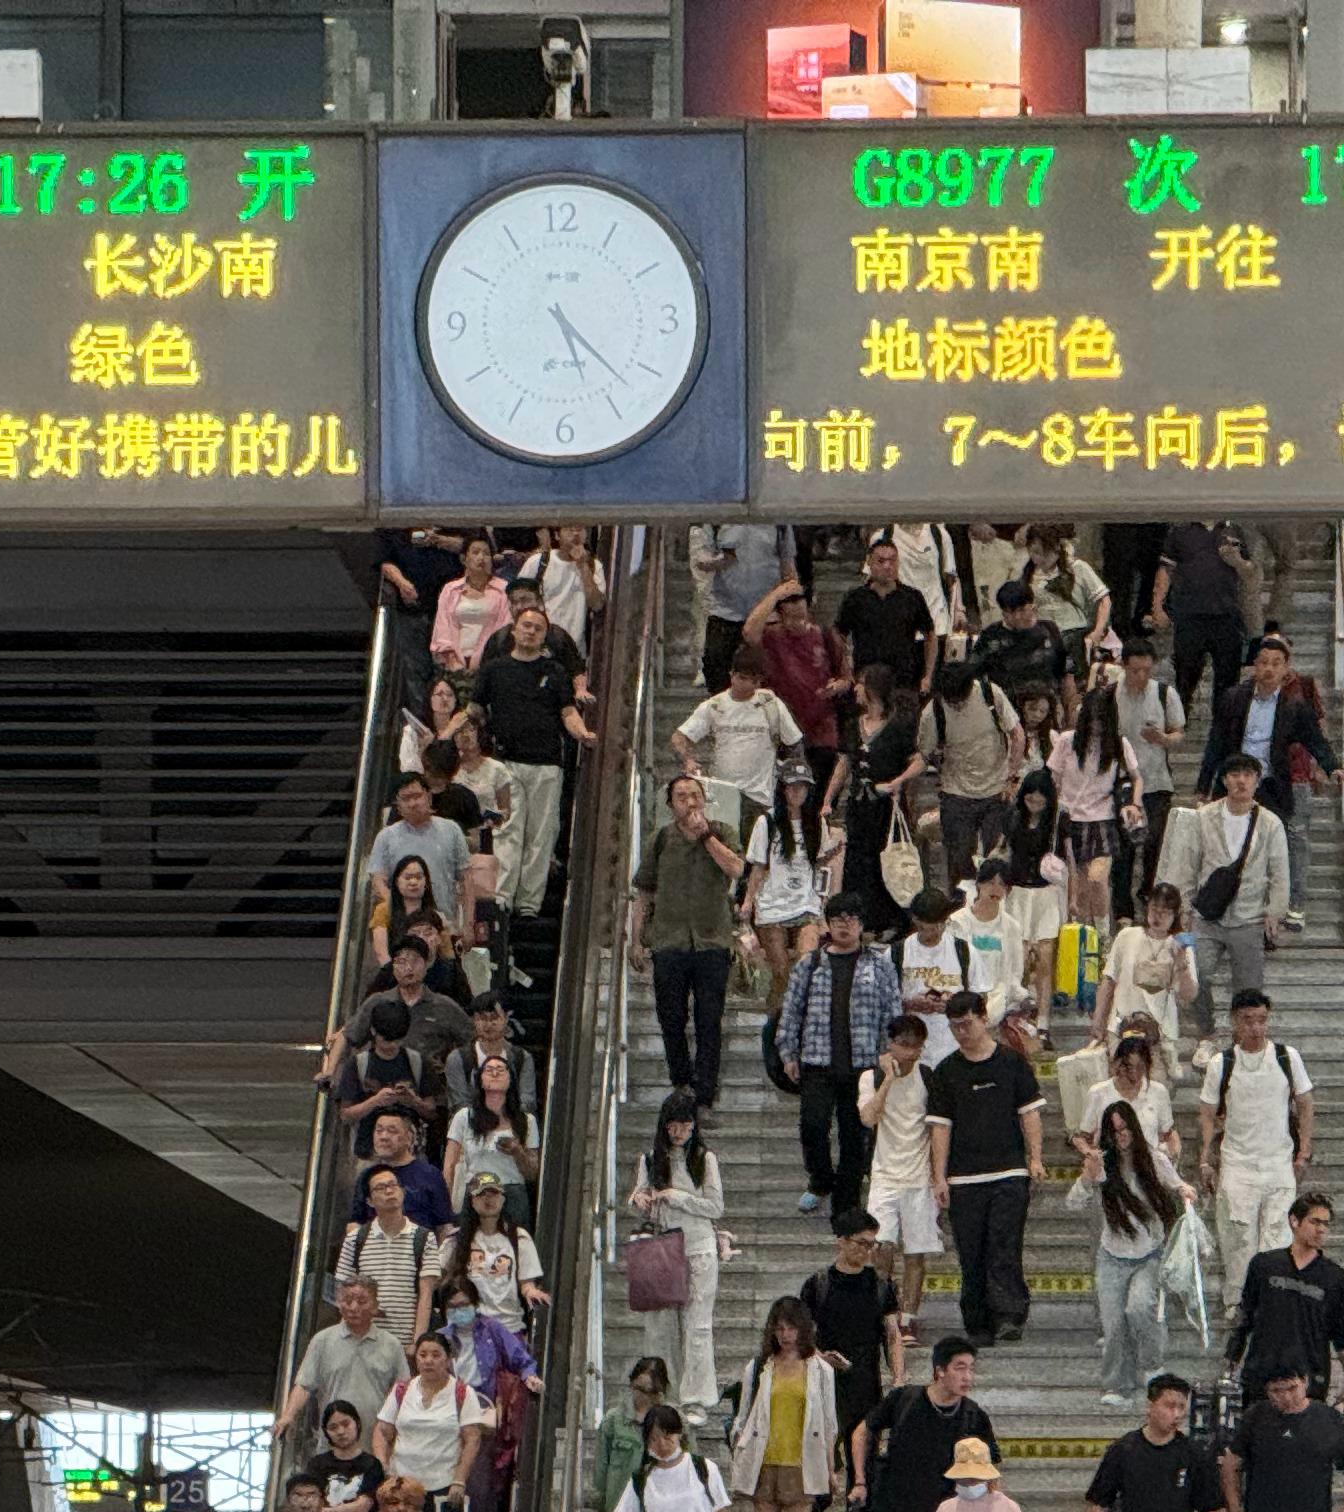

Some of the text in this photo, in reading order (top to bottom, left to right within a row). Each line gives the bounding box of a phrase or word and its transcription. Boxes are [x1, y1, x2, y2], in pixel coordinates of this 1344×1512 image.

[236, 145, 315, 222] 开
[852, 147, 1054, 208] G8977
[1124, 134, 1201, 215] 次
[544, 203, 578, 233] 12
[86, 232, 274, 299] 长沙南
[852, 226, 1042, 294] 南京南
[1152, 225, 1280, 289] 开往
[447, 311, 467, 342] 9
[658, 304, 679, 335] 3
[864, 315, 1121, 382] 地标颜色
[69, 321, 199, 391] 绿色
[555, 413, 575, 444] 6
[170, 1480, 205, 1504] 25
